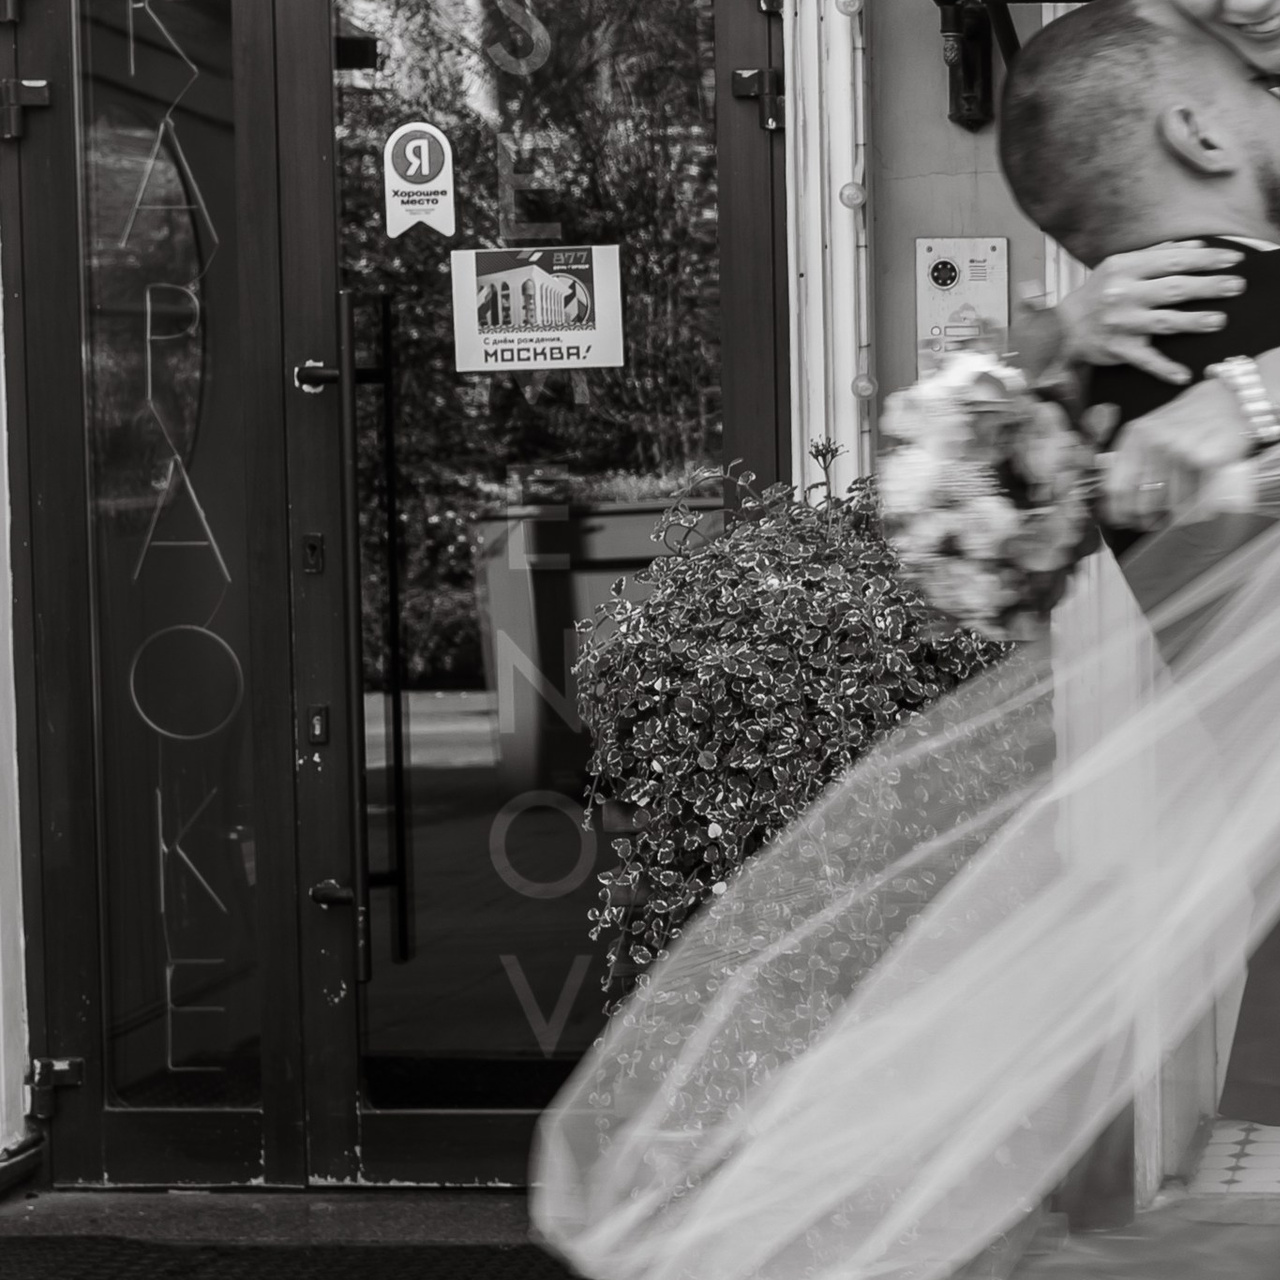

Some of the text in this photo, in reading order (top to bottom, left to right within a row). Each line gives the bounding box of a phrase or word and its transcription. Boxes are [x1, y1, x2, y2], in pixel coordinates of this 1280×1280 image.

[405, 139, 430, 176] Я
[392, 189, 447, 199] Хорошее
[553, 252, 588, 264] 877
[483, 337, 490, 345] С
[484, 345, 592, 363] МОСКВА!
